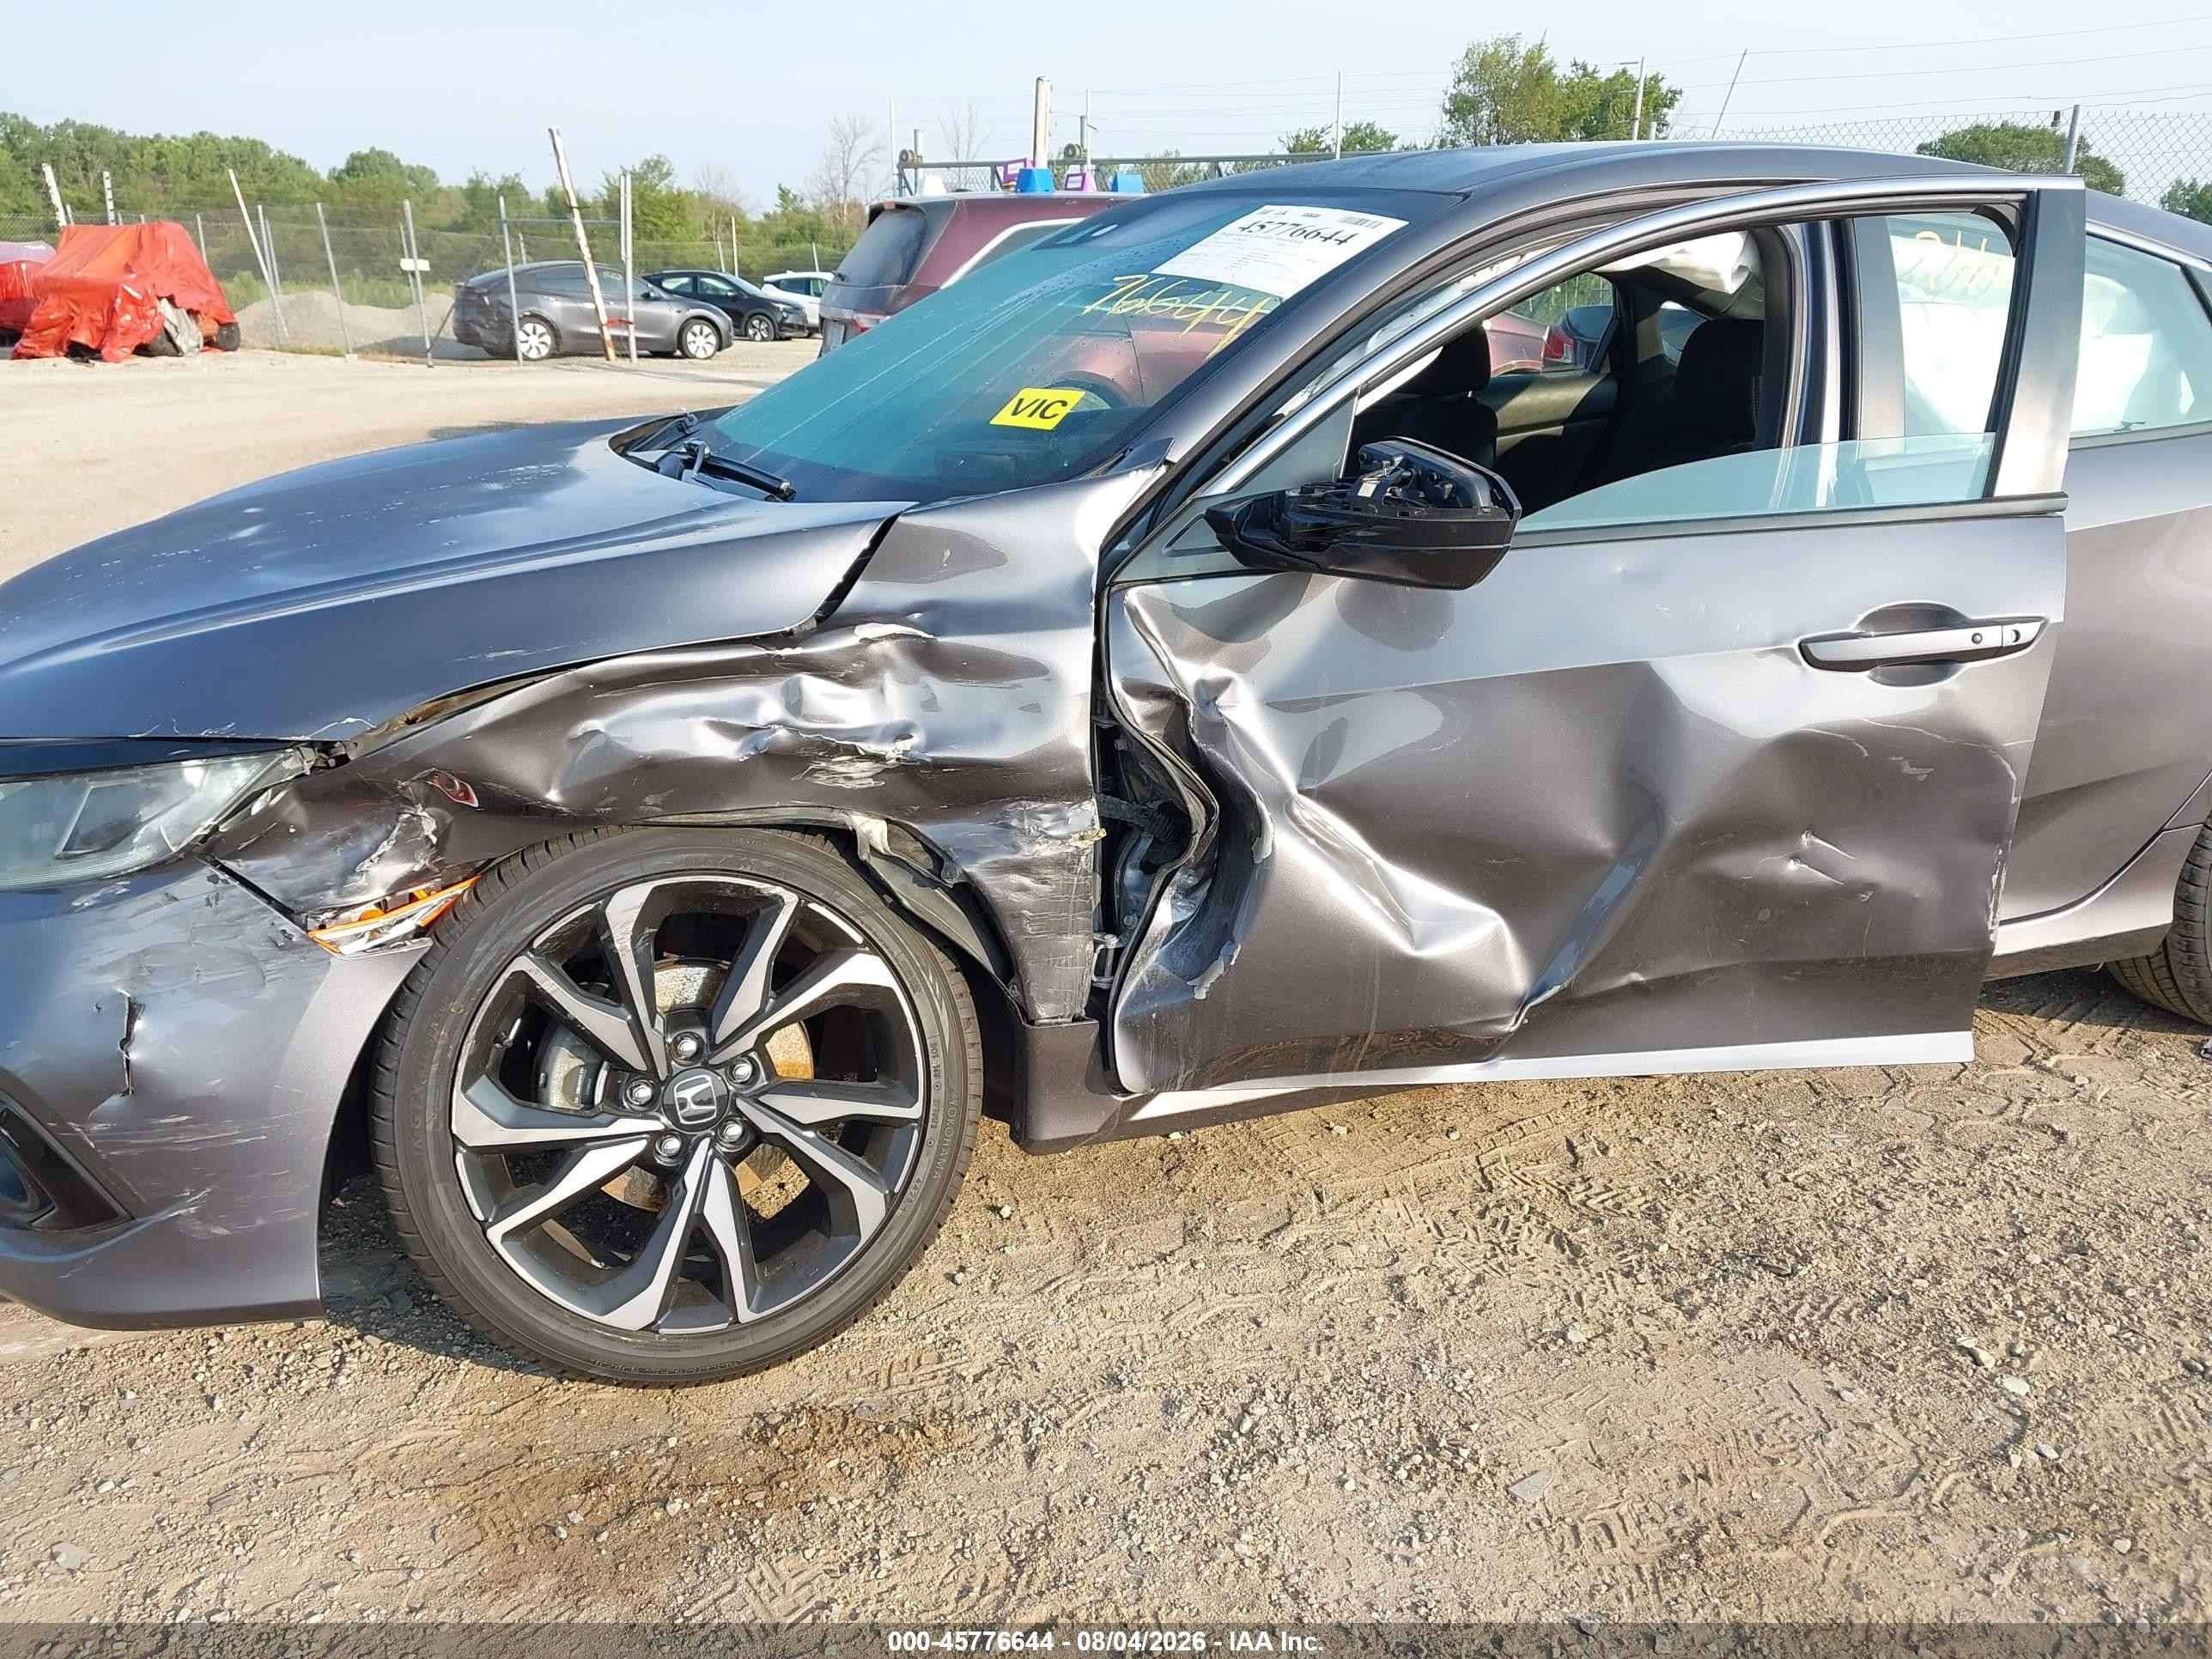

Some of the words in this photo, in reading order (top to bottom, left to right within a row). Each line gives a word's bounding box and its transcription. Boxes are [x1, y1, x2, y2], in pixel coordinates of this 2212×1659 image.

[1239, 221, 1358, 246] 45776644
[1011, 398, 1068, 419] VIC
[933, 1100, 957, 1181] YOKOHAMA
